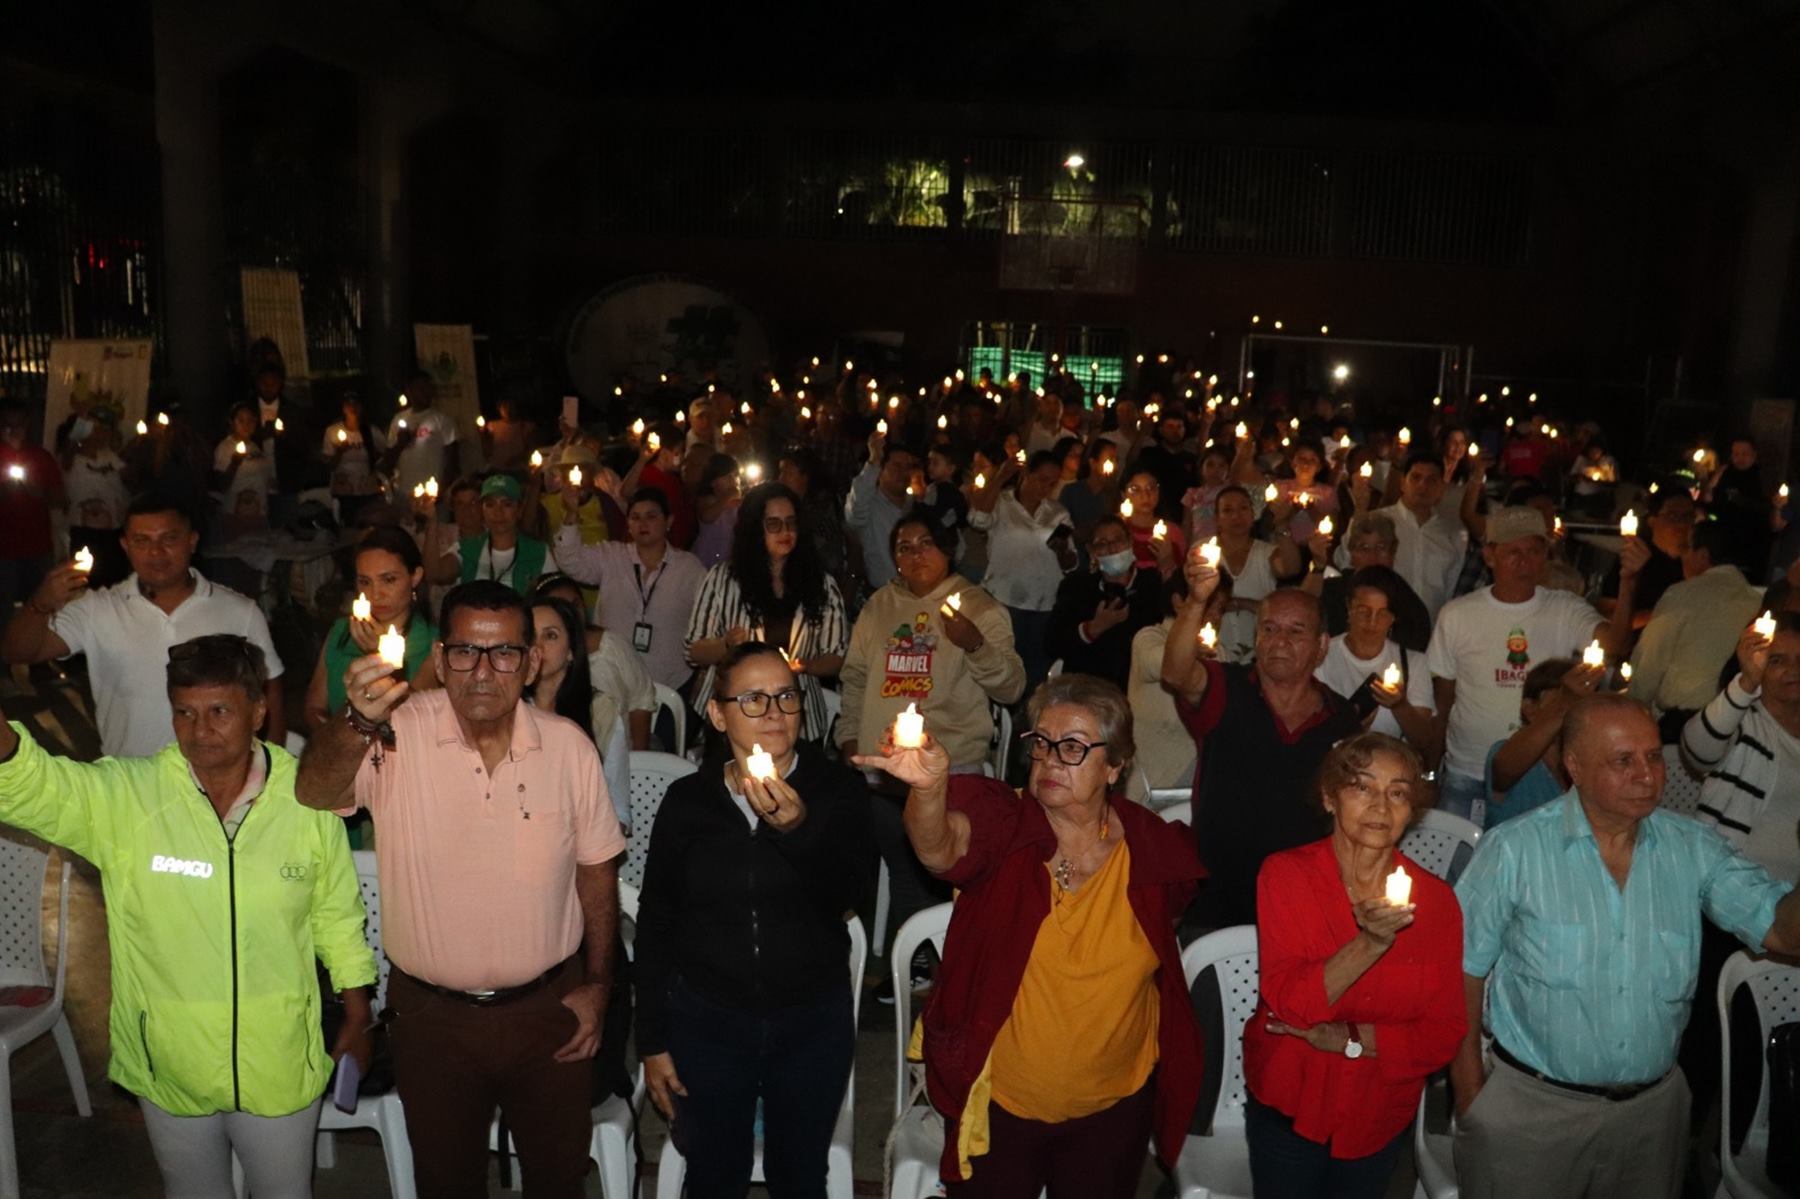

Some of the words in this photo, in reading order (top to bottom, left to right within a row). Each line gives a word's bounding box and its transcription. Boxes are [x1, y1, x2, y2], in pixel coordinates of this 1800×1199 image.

[888, 654, 928, 672] MARVEL
[1495, 668, 1526, 682] IBAG
[881, 676, 933, 698] COMICS
